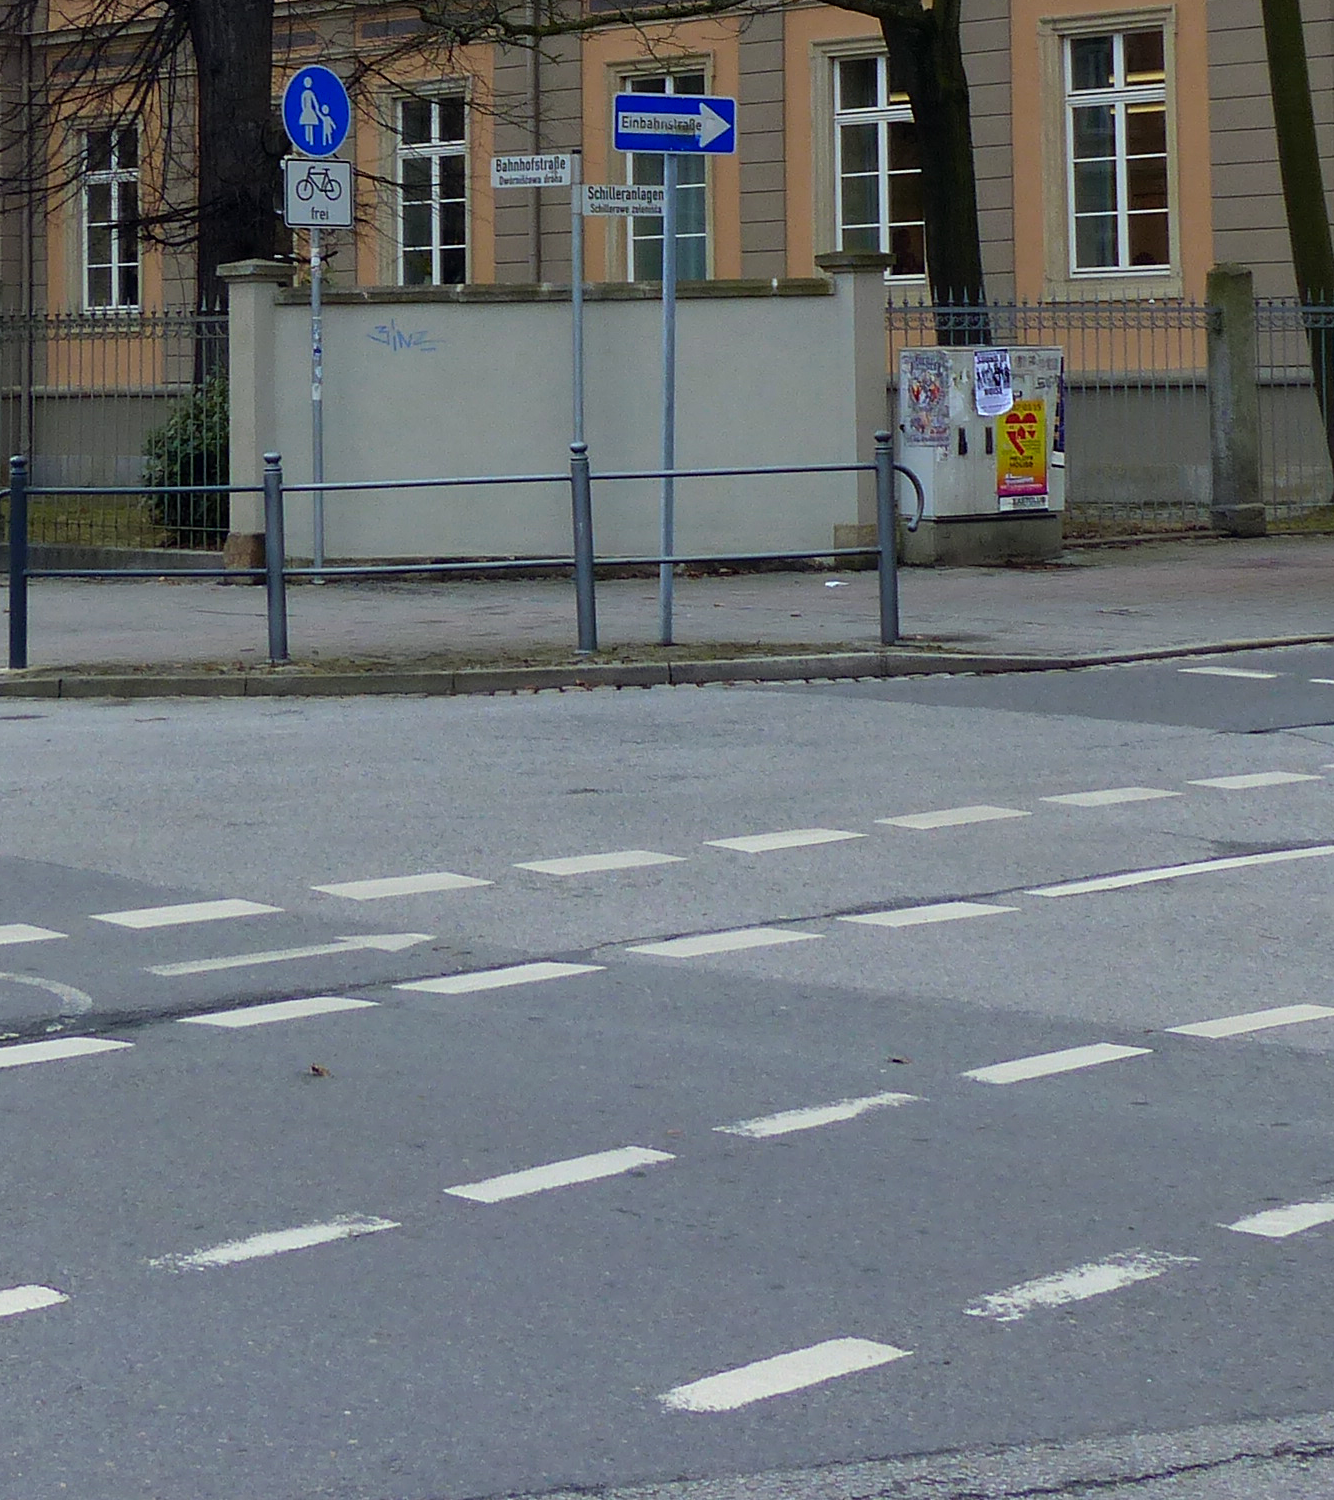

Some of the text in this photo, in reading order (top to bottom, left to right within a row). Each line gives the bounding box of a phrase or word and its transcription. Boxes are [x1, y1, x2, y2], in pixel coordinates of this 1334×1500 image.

[621, 115, 702, 132] Einbahnstraße
[496, 156, 566, 173] Bahnhofstraße
[588, 186, 664, 204] Schilleranlagen
[311, 206, 329, 220] frei
